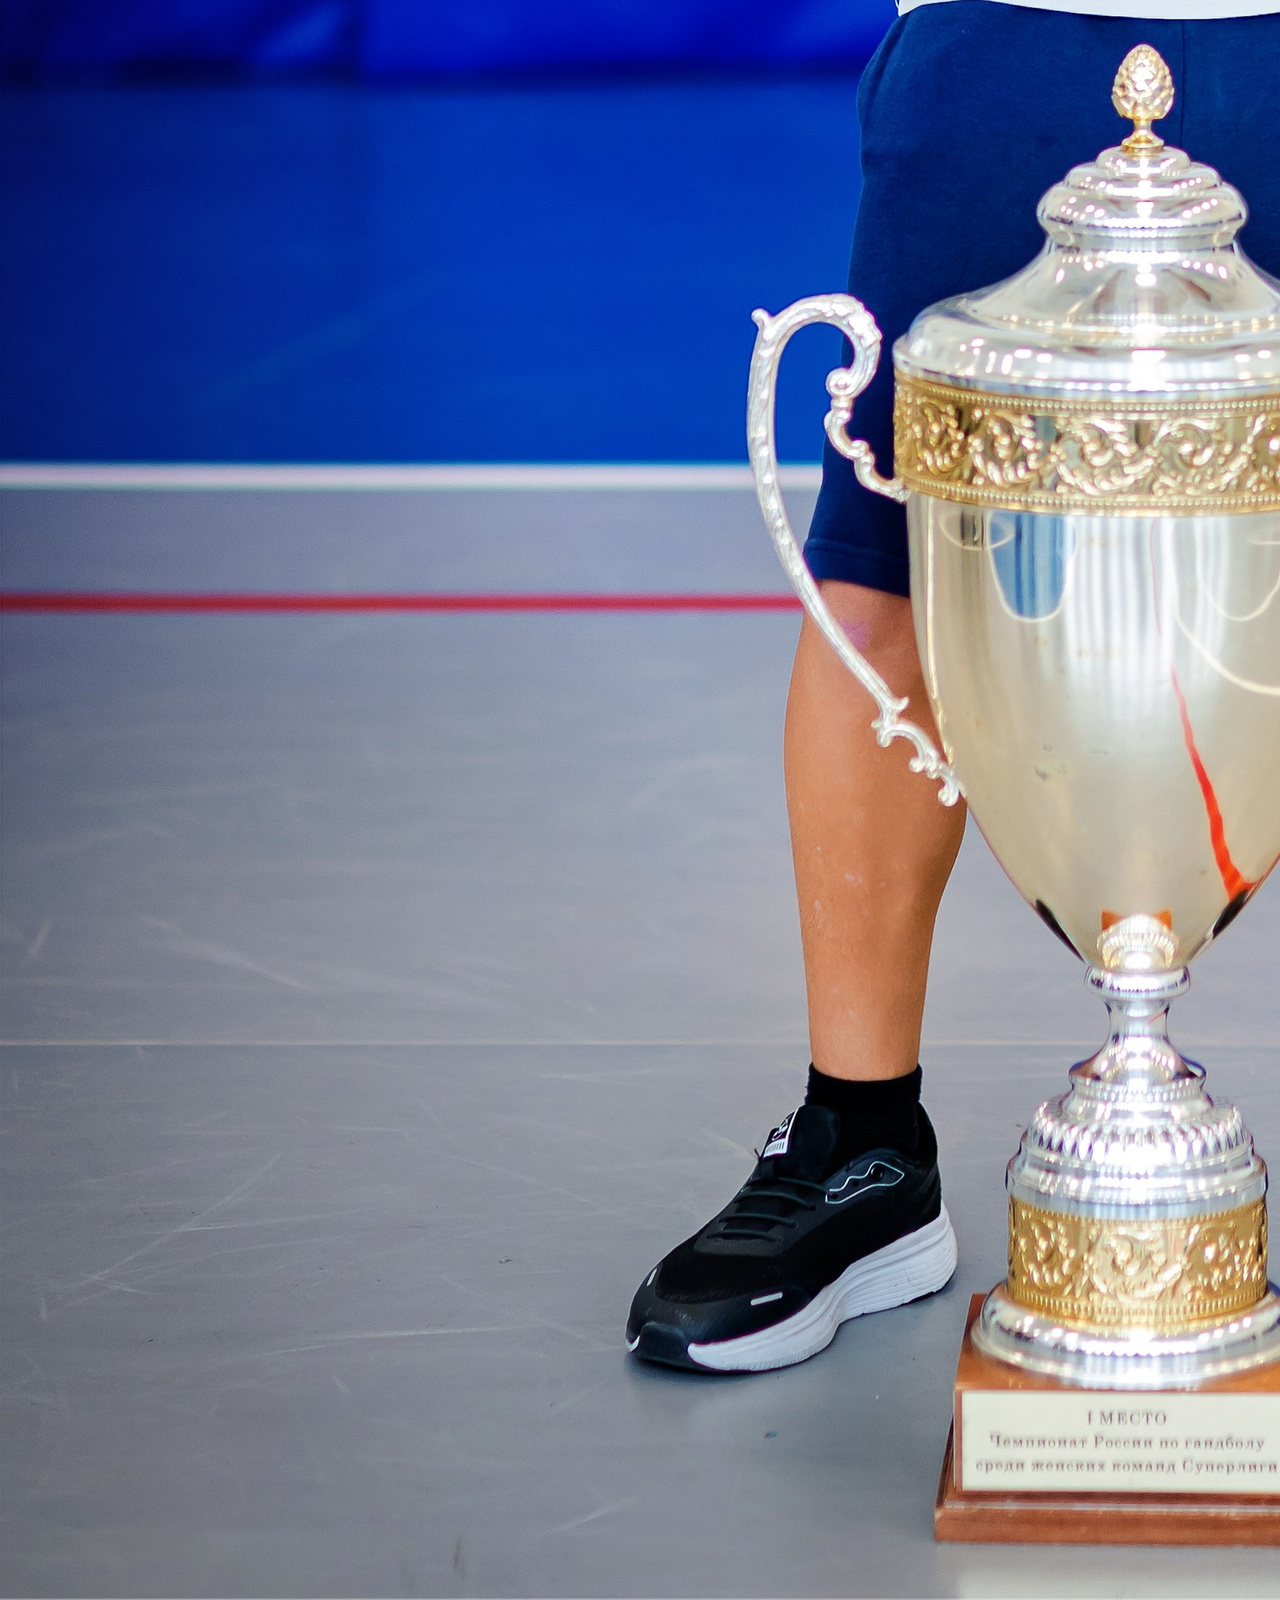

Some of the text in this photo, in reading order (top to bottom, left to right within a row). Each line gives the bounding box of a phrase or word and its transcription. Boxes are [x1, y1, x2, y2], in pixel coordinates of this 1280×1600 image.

[1099, 1411, 1168, 1426] МЕСТО
[989, 1434, 1266, 1452] Чемпионат России по гандболу
[975, 1458, 1278, 1476] среди женских команд Суперлиги
